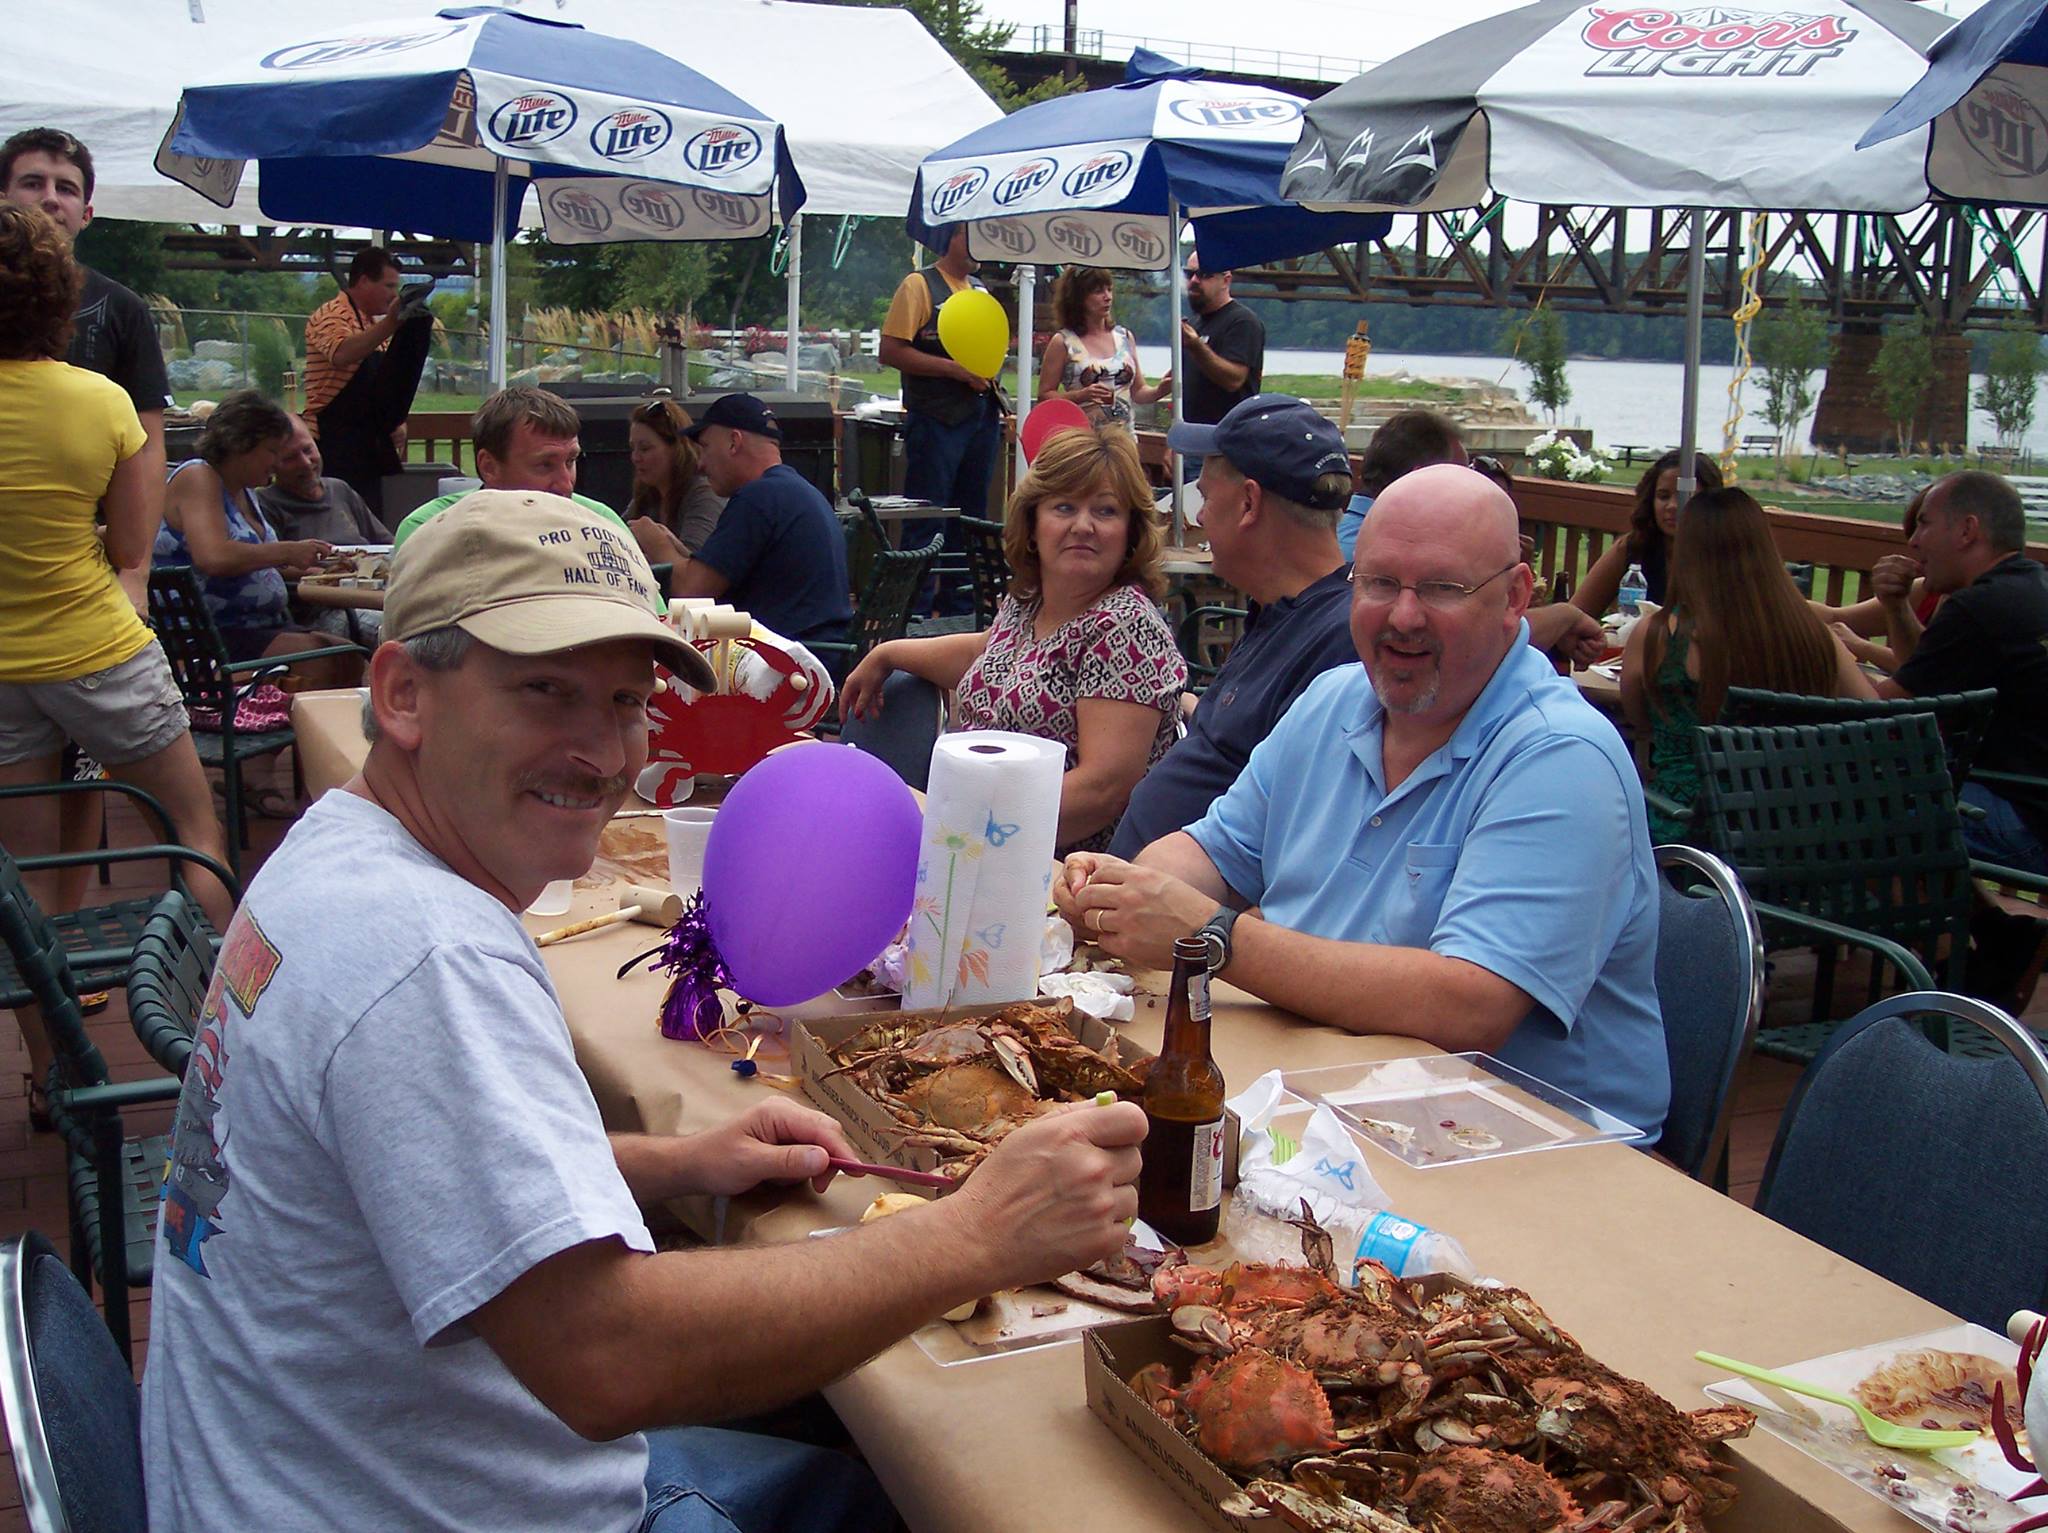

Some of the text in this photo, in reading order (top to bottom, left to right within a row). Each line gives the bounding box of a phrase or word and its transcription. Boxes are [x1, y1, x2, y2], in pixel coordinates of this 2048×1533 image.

[1583, 6, 1856, 51] Coors
[1584, 48, 1843, 77] LIGHT
[513, 97, 557, 112] Miller
[1197, 105, 1287, 126] Lite
[503, 108, 566, 142] Lite
[612, 112, 650, 128] Miller
[603, 123, 661, 156] Lite
[705, 129, 741, 144] Miller
[699, 140, 751, 171] Lite
[1003, 168, 1049, 204] Lite
[1072, 161, 1122, 195] Lite
[939, 177, 980, 214] Lite
[538, 529, 572, 546] PRO
[564, 567, 600, 584] HALL
[606, 572, 621, 587] OF
